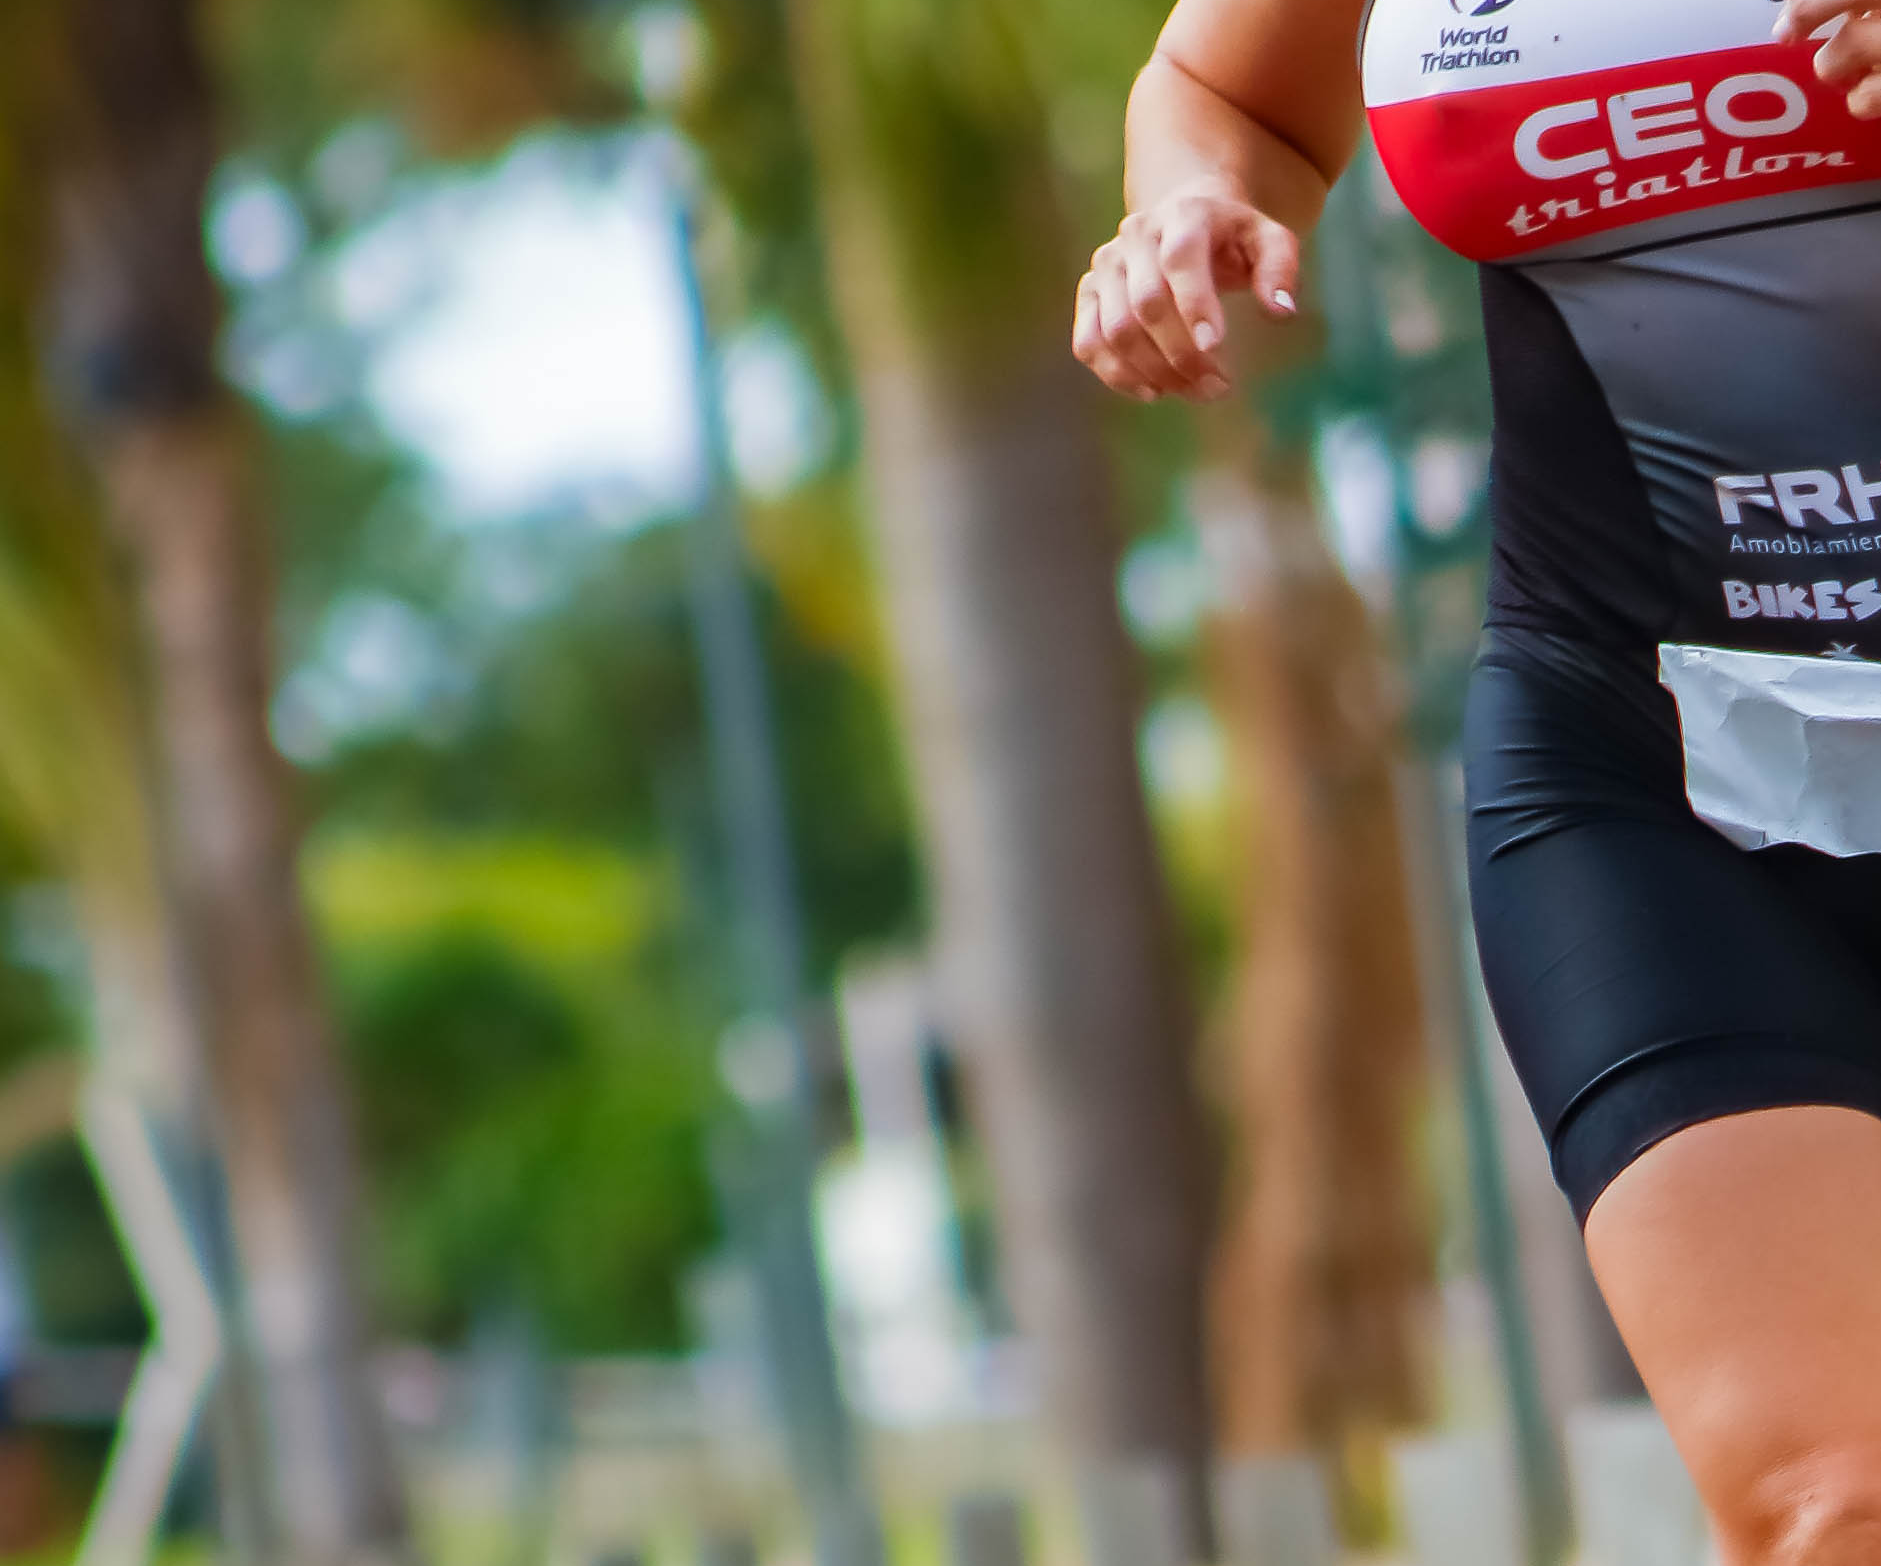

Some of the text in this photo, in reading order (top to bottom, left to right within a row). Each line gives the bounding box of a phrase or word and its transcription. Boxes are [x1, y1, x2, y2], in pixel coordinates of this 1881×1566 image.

[1420, 47, 1520, 74] Triathlon
[1440, 25, 1508, 48] World
[1513, 72, 1808, 180] CEO
[1505, 146, 1854, 235] triatlon
